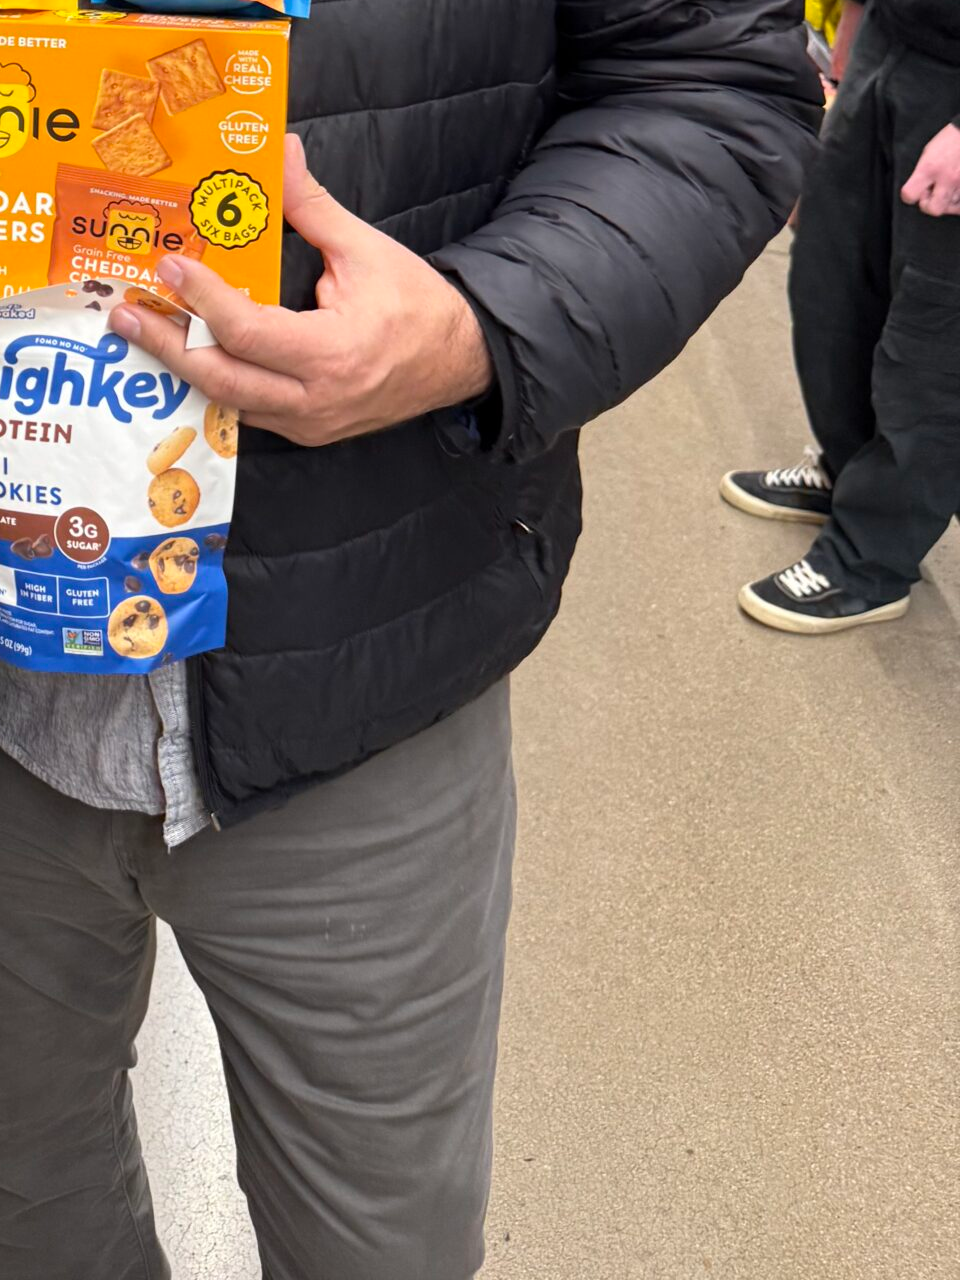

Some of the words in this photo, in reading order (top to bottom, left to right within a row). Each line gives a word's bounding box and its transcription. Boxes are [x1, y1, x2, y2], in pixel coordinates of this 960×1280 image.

[18, 37, 67, 49] BETTER
[233, 63, 264, 74] REAL
[224, 75, 271, 87] CHEESE
[218, 121, 269, 133] GLUTEN
[228, 133, 259, 145] FREE
[197, 177, 263, 212] MULTIPACK
[216, 191, 242, 228] 6
[200, 219, 218, 238] SIX
[223, 223, 258, 242] BAGS
[73, 244, 103, 258] Grain
[106, 250, 131, 263] Free
[68, 516, 98, 539] 3G
[24, 582, 46, 593] HIGH
[66, 588, 100, 598] GLUTEN
[20, 589, 30, 598] IN
[30, 591, 53, 603] FIBER
[72, 598, 94, 607] FREE
[4, 637, 13, 648] OZ
[13, 640, 33, 657] (99g)
